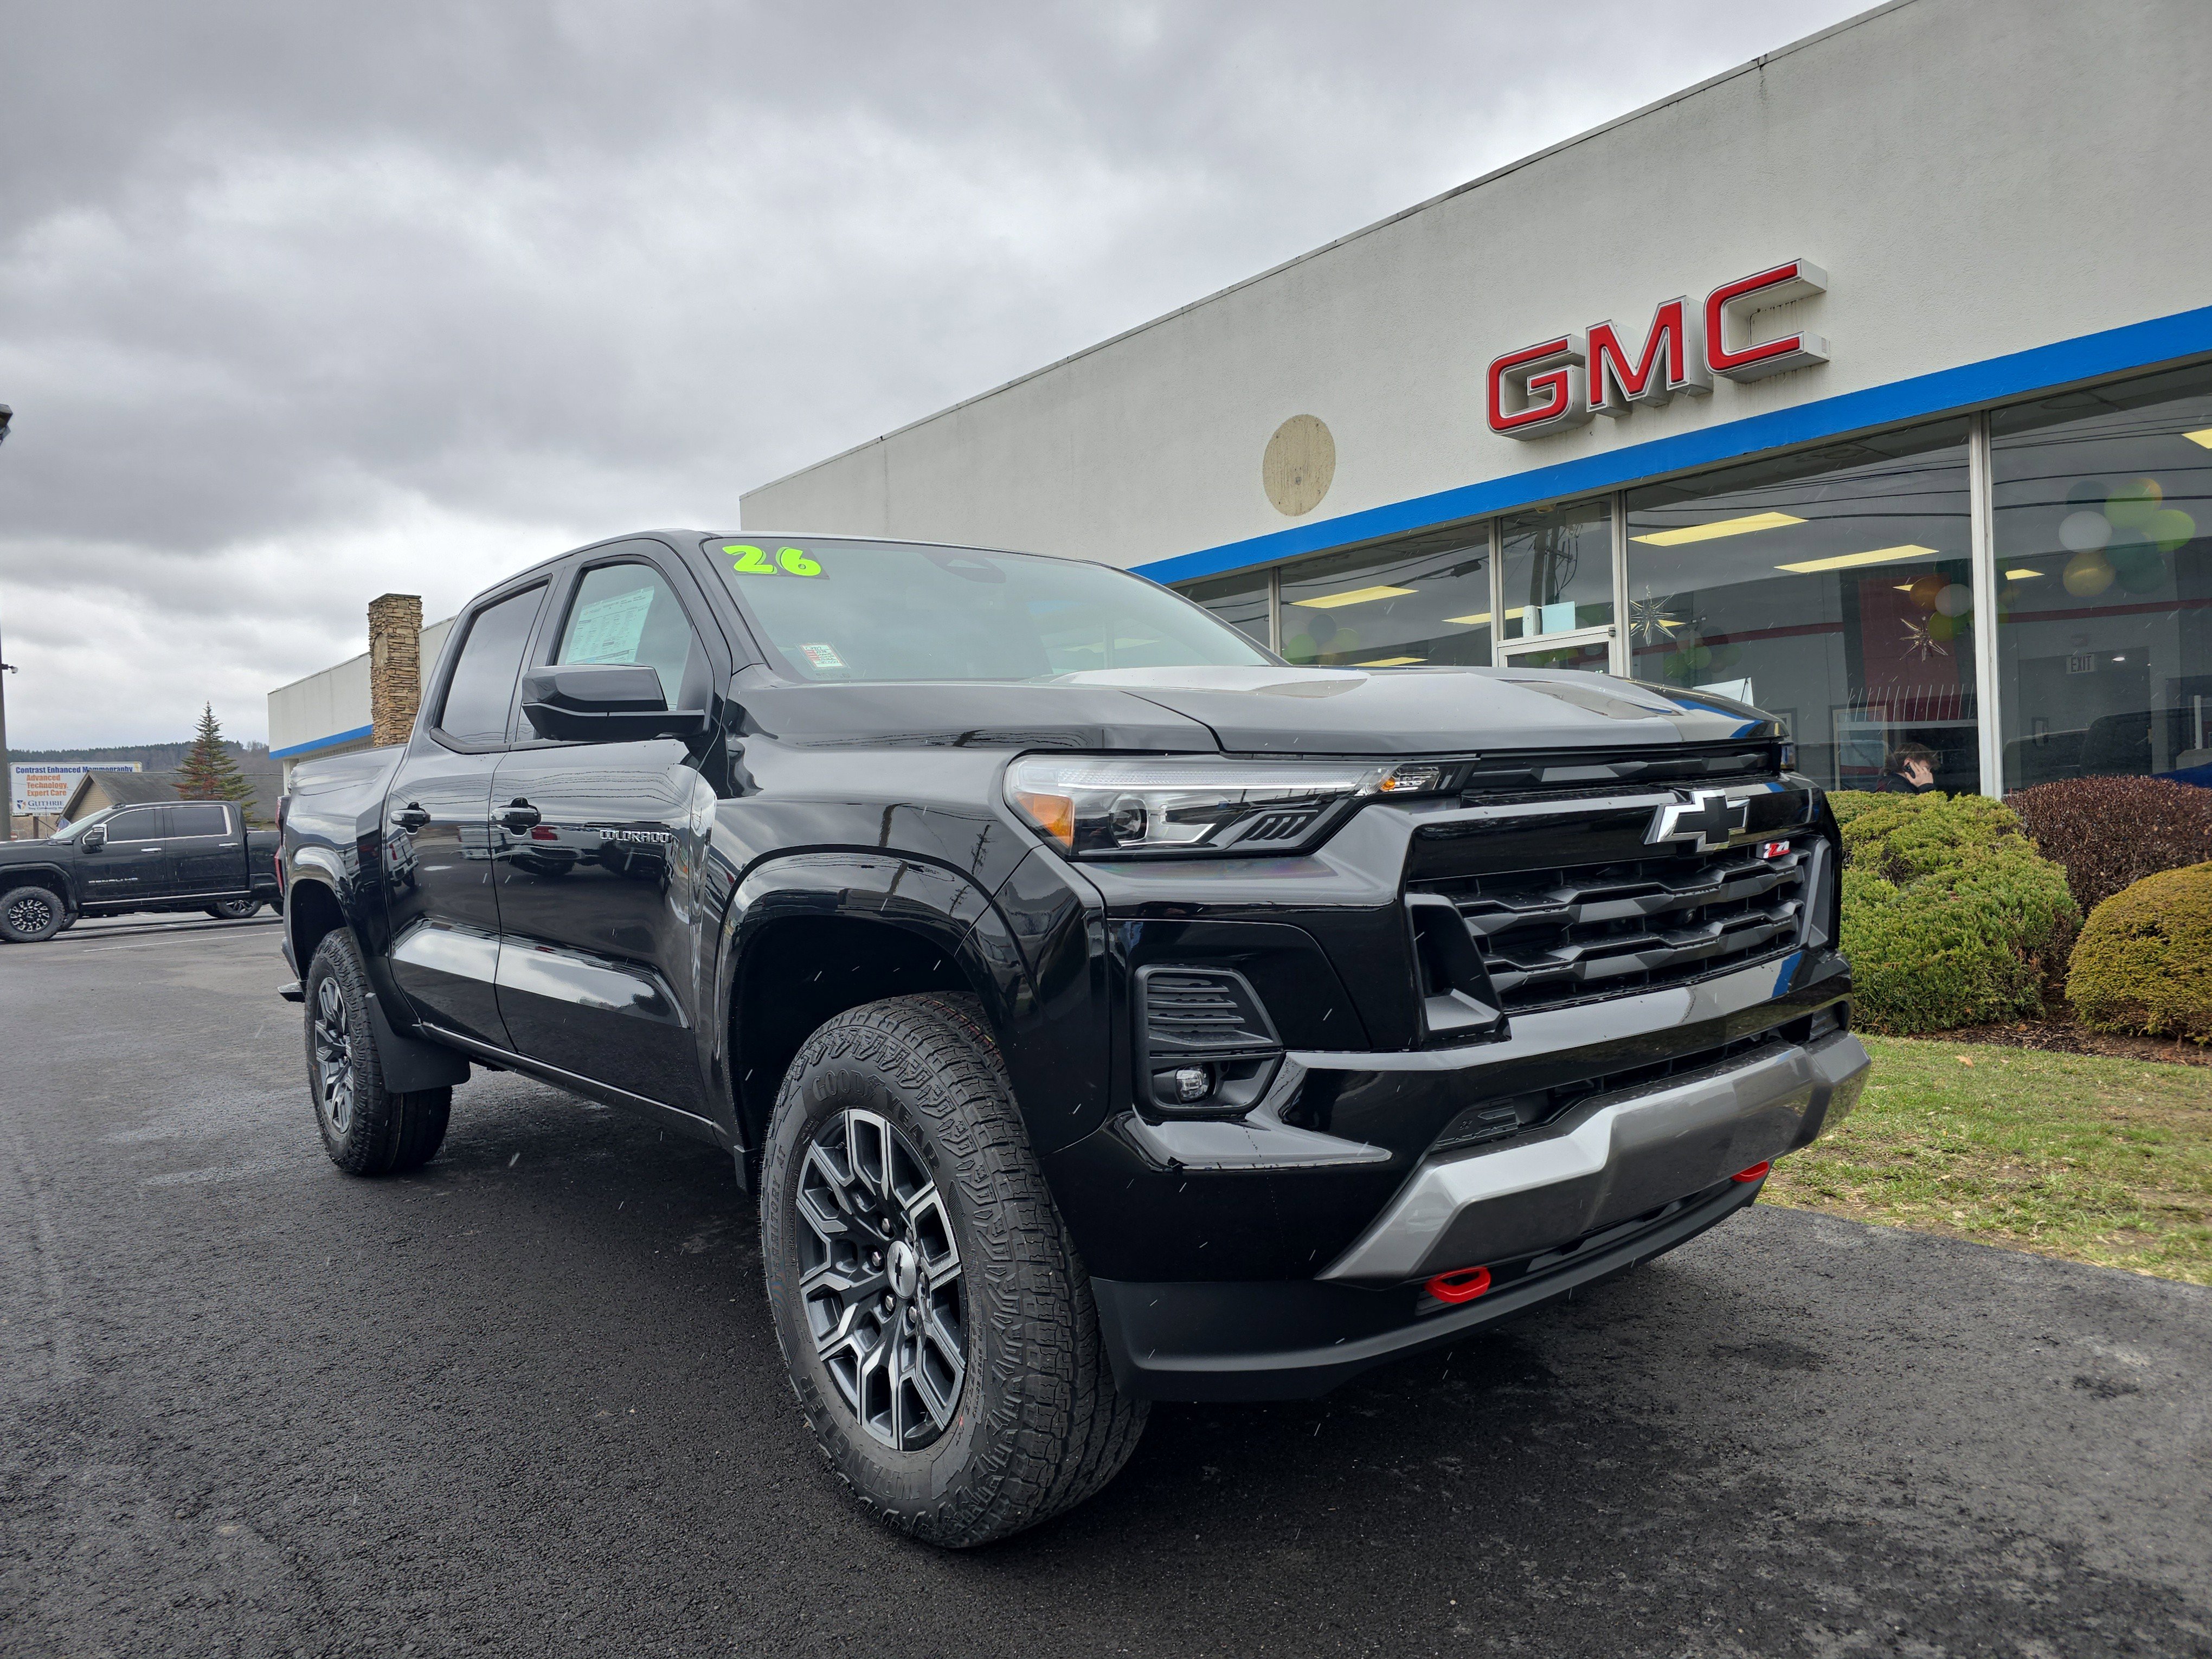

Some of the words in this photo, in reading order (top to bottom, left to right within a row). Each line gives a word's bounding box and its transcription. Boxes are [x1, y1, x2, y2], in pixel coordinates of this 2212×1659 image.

[1487, 258, 1806, 434] GMC
[722, 545, 821, 576] 26
[2071, 655, 2092, 672] EXIT
[600, 829, 672, 843] COLORADO
